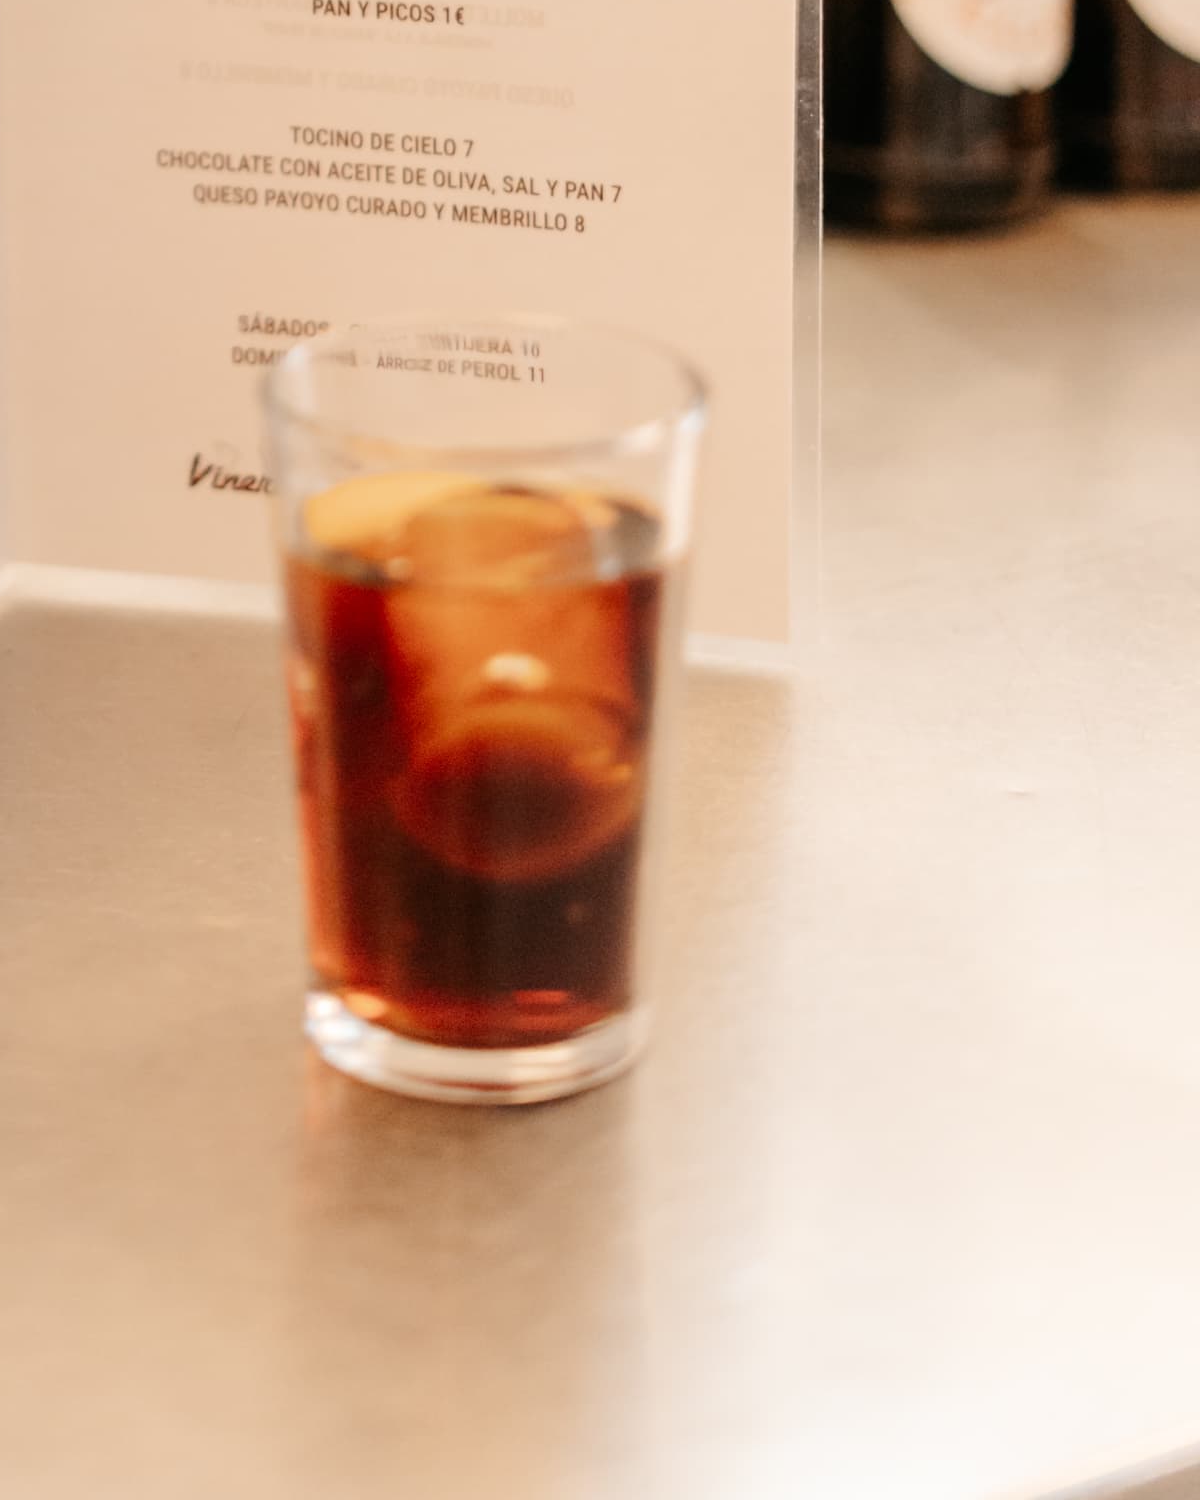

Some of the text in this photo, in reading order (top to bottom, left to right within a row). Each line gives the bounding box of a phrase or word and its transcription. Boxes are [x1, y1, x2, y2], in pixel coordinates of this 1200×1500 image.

[357, 0, 369, 18] Y
[376, 1, 435, 23] PICOS
[443, 6, 464, 25] 1€
[290, 125, 474, 157] TOCINO DE CIELO 7
[156, 149, 622, 203] CHOCOLATE CON ACEITE DE OLIVA, SAL Y PAN 7
[193, 184, 585, 233] QUESO PAYOYO CURADO Y MEMBRILLO 8
[437, 358, 456, 374] DE
[461, 360, 521, 381] PEROL
[527, 365, 546, 383] 11
[189, 451, 272, 493] Viner
